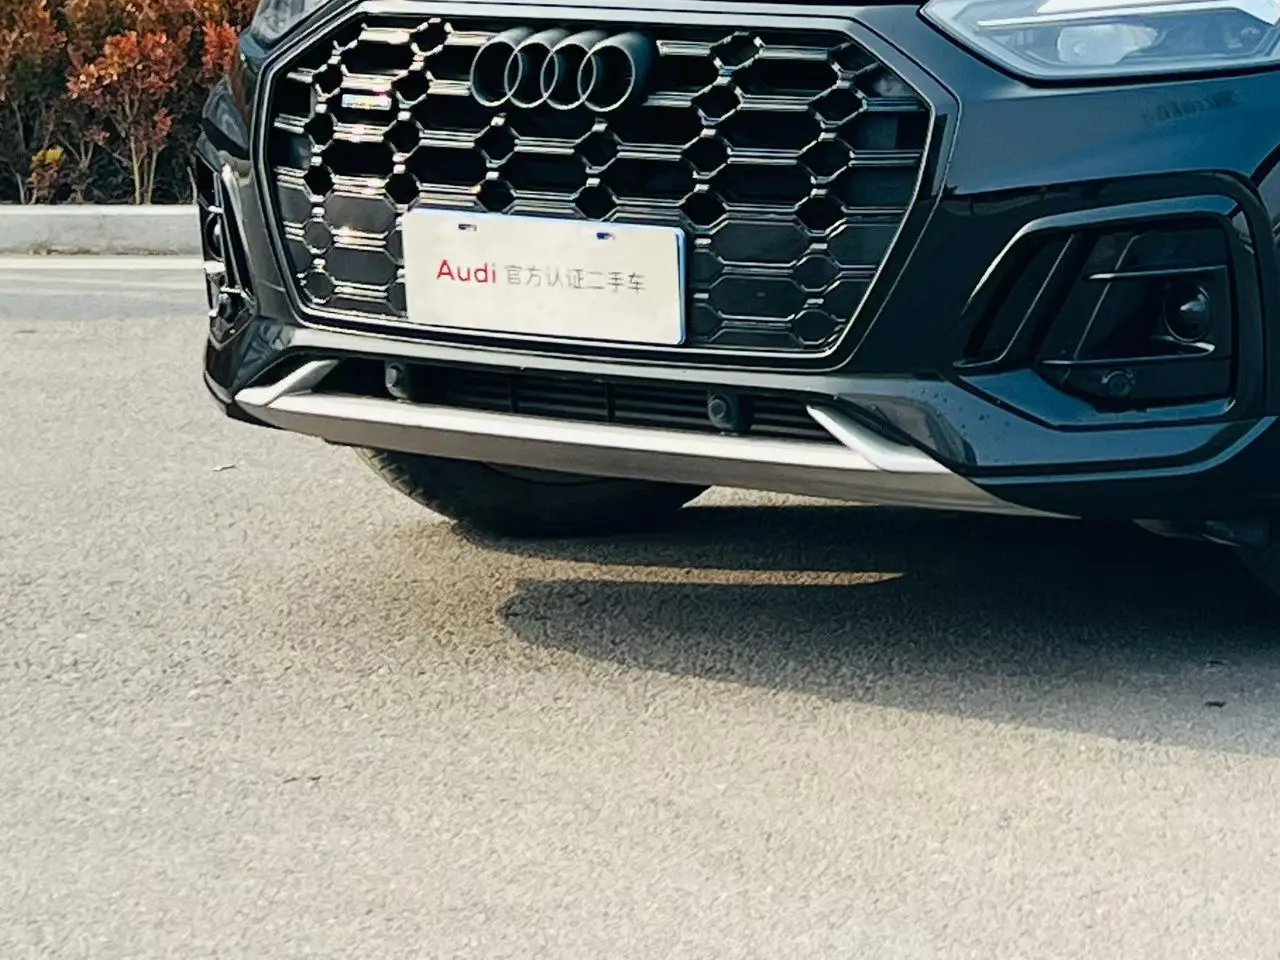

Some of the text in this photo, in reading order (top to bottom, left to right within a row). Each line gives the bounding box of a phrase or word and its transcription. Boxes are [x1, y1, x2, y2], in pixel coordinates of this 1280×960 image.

[436, 258, 648, 294] Audi 官方认证二手车
